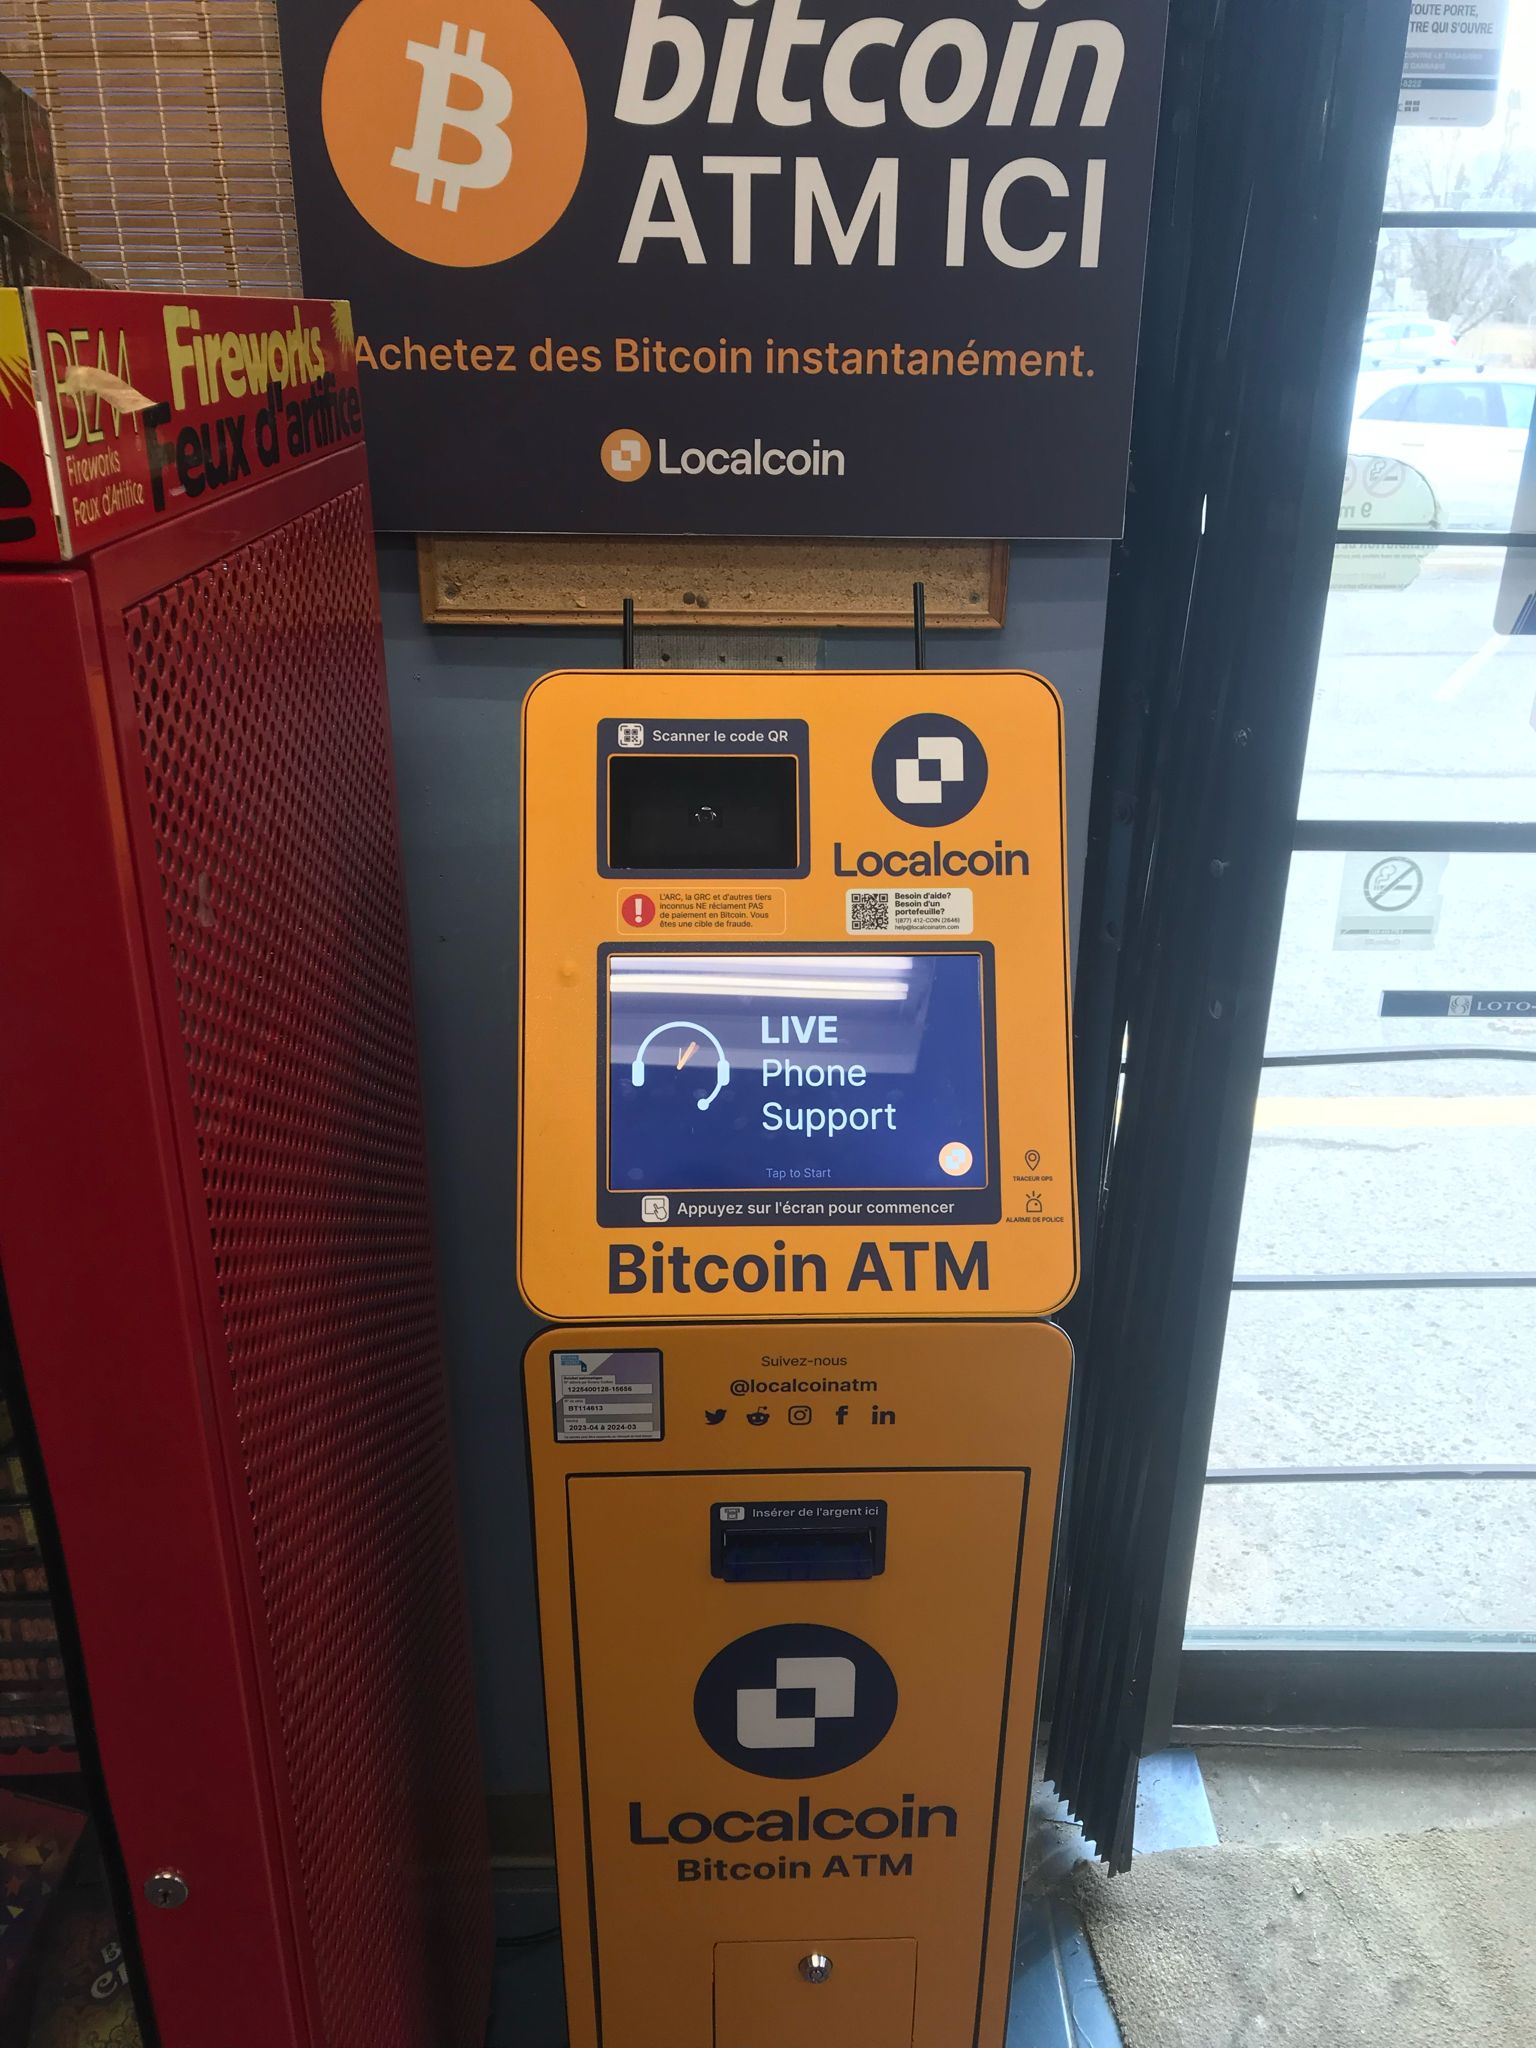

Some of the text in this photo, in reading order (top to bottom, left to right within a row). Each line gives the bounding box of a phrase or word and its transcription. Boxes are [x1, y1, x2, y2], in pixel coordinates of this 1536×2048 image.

[1443, 4, 1479, 18] PORTE,
[1431, 21, 1449, 34] QUI
[1450, 22, 1493, 34] S'OUVRE
[613, 0, 1125, 128] bitcoin
[617, 155, 1106, 269] ATM ICI
[162, 305, 326, 411] Fireworks
[354, 335, 1095, 378] Achetez des Bitcoin instantanément.
[143, 402, 251, 513] Feux
[255, 371, 363, 468] d'artifice
[65, 449, 121, 488] Fireworks
[659, 438, 846, 477] Localcoin
[72, 495, 100, 528] Feux
[652, 728, 789, 744] Scanner le code QR
[833, 840, 1029, 877] Localcoin
[659, 902, 694, 910] inconnus
[660, 893, 683, 901] L'ARC,
[659, 911, 670, 919] de
[671, 911, 707, 921] paiement
[750, 911, 769, 919] Vous
[659, 920, 676, 928] êtes
[694, 920, 713, 928] cible
[715, 920, 725, 928] de
[726, 920, 753, 928] fraude.
[894, 908, 945, 916] portefeuille?
[761, 1015, 838, 1044] LIVE
[762, 1058, 867, 1087] Phone
[762, 1101, 897, 1137] Support
[765, 1168, 831, 1179] Tap to Start
[677, 1201, 955, 1218] Appuyez sur l'écran pour commencer
[608, 1239, 989, 1294] Bitcoin ATM
[761, 1355, 848, 1367] Suivez-nous
[730, 1378, 878, 1396] @localcoinatm
[752, 1506, 879, 1519] Insérer de l'argent ici
[628, 1792, 958, 1846] Localcoin
[677, 1853, 913, 1882] Bitcoin ATM
